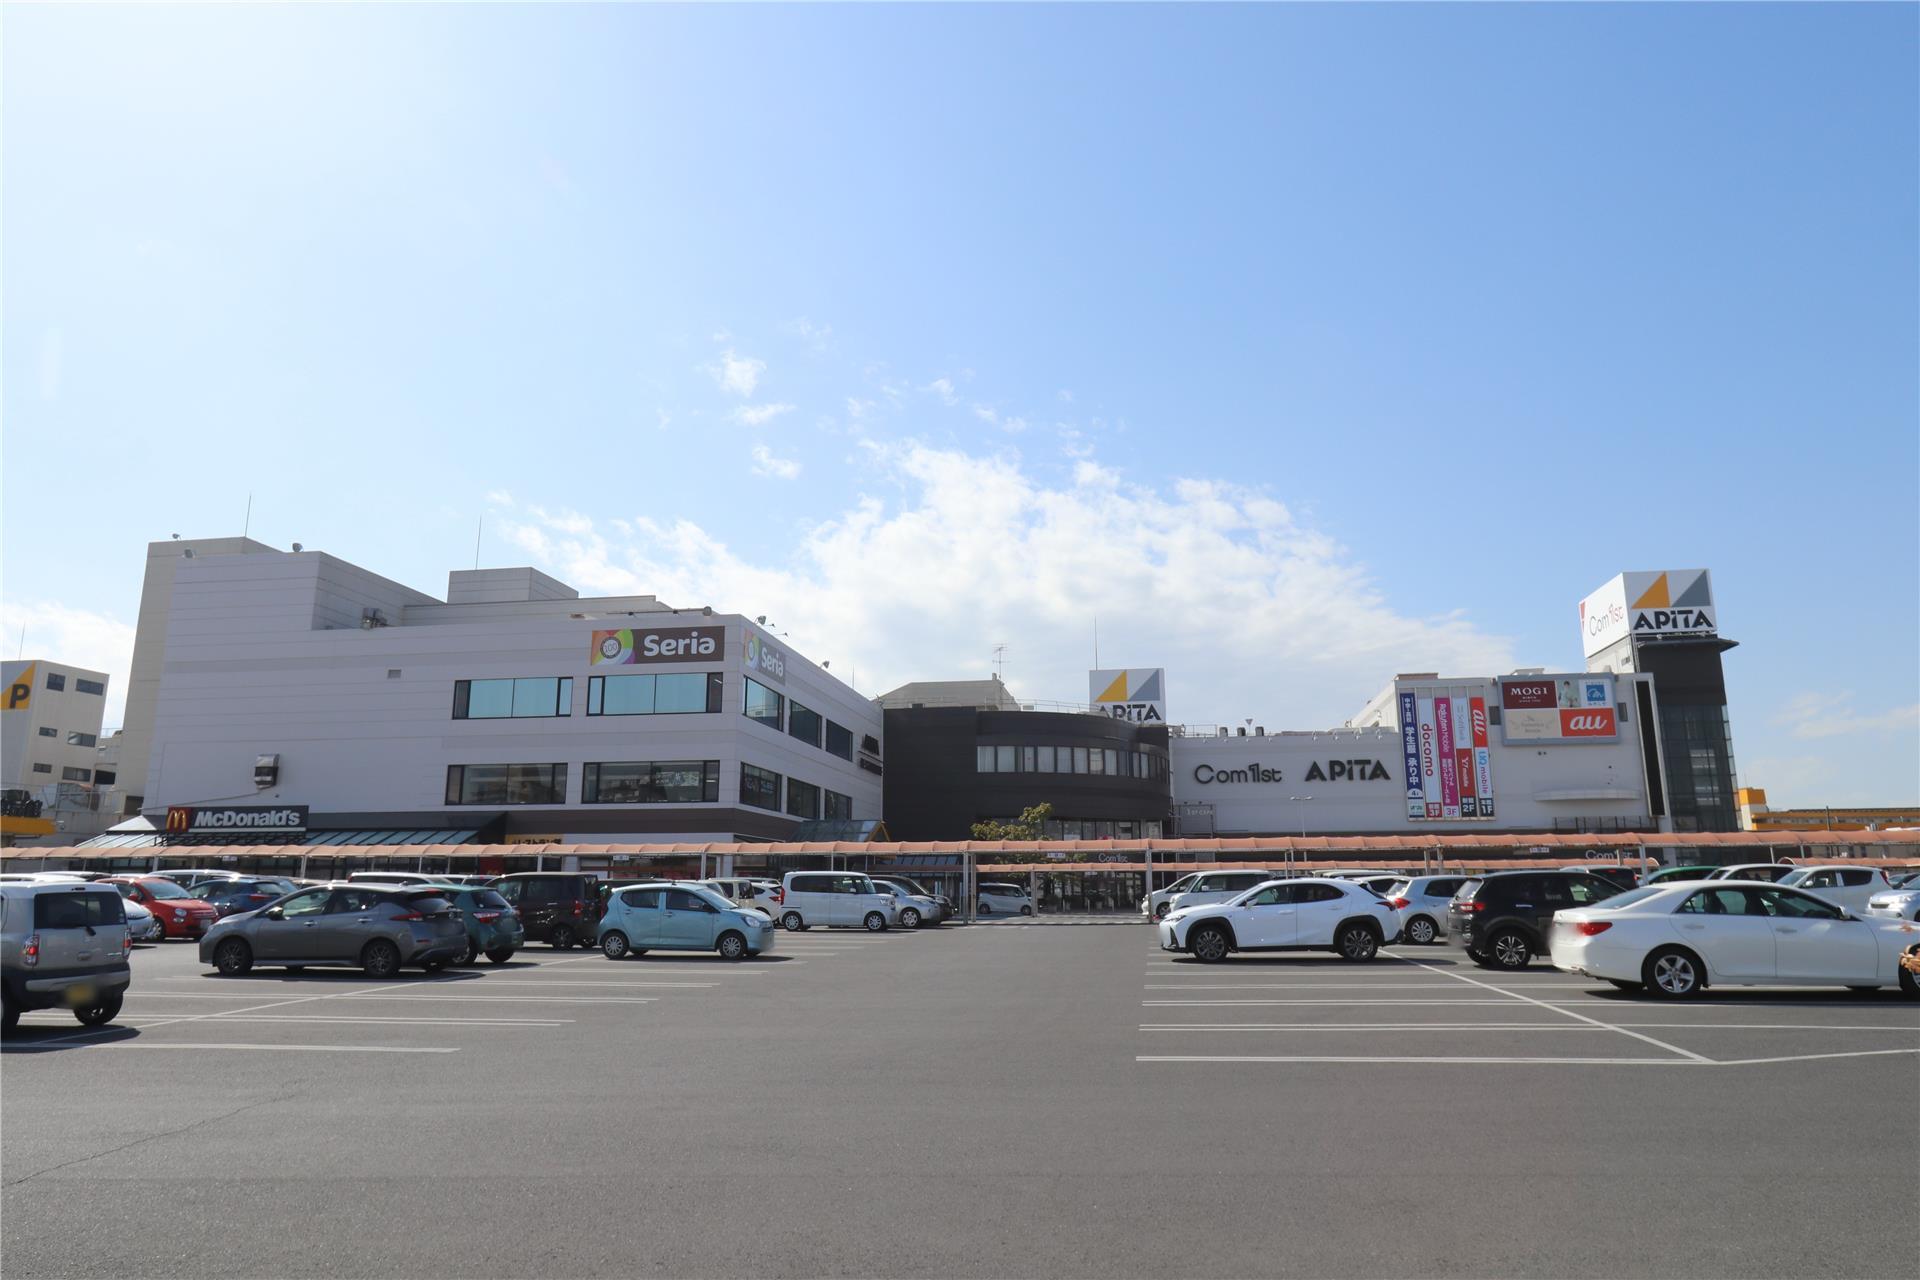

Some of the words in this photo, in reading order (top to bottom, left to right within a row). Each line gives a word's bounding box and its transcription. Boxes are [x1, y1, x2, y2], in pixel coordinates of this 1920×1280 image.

[643, 631, 716, 657] Seria
[761, 647, 784, 677] Seria
[9, 684, 30, 709] P
[1511, 686, 1548, 696] MOGI
[1472, 709, 1486, 736] au
[1570, 715, 1607, 730] au
[1405, 726, 1416, 753] 学生服
[1421, 723, 1433, 777] docomo
[1407, 757, 1419, 786] 承り中
[1480, 767, 1489, 794] mobile
[194, 810, 300, 827] McDonald's
[1462, 804, 1475, 813] 2F
[1481, 805, 1493, 813] 1F
